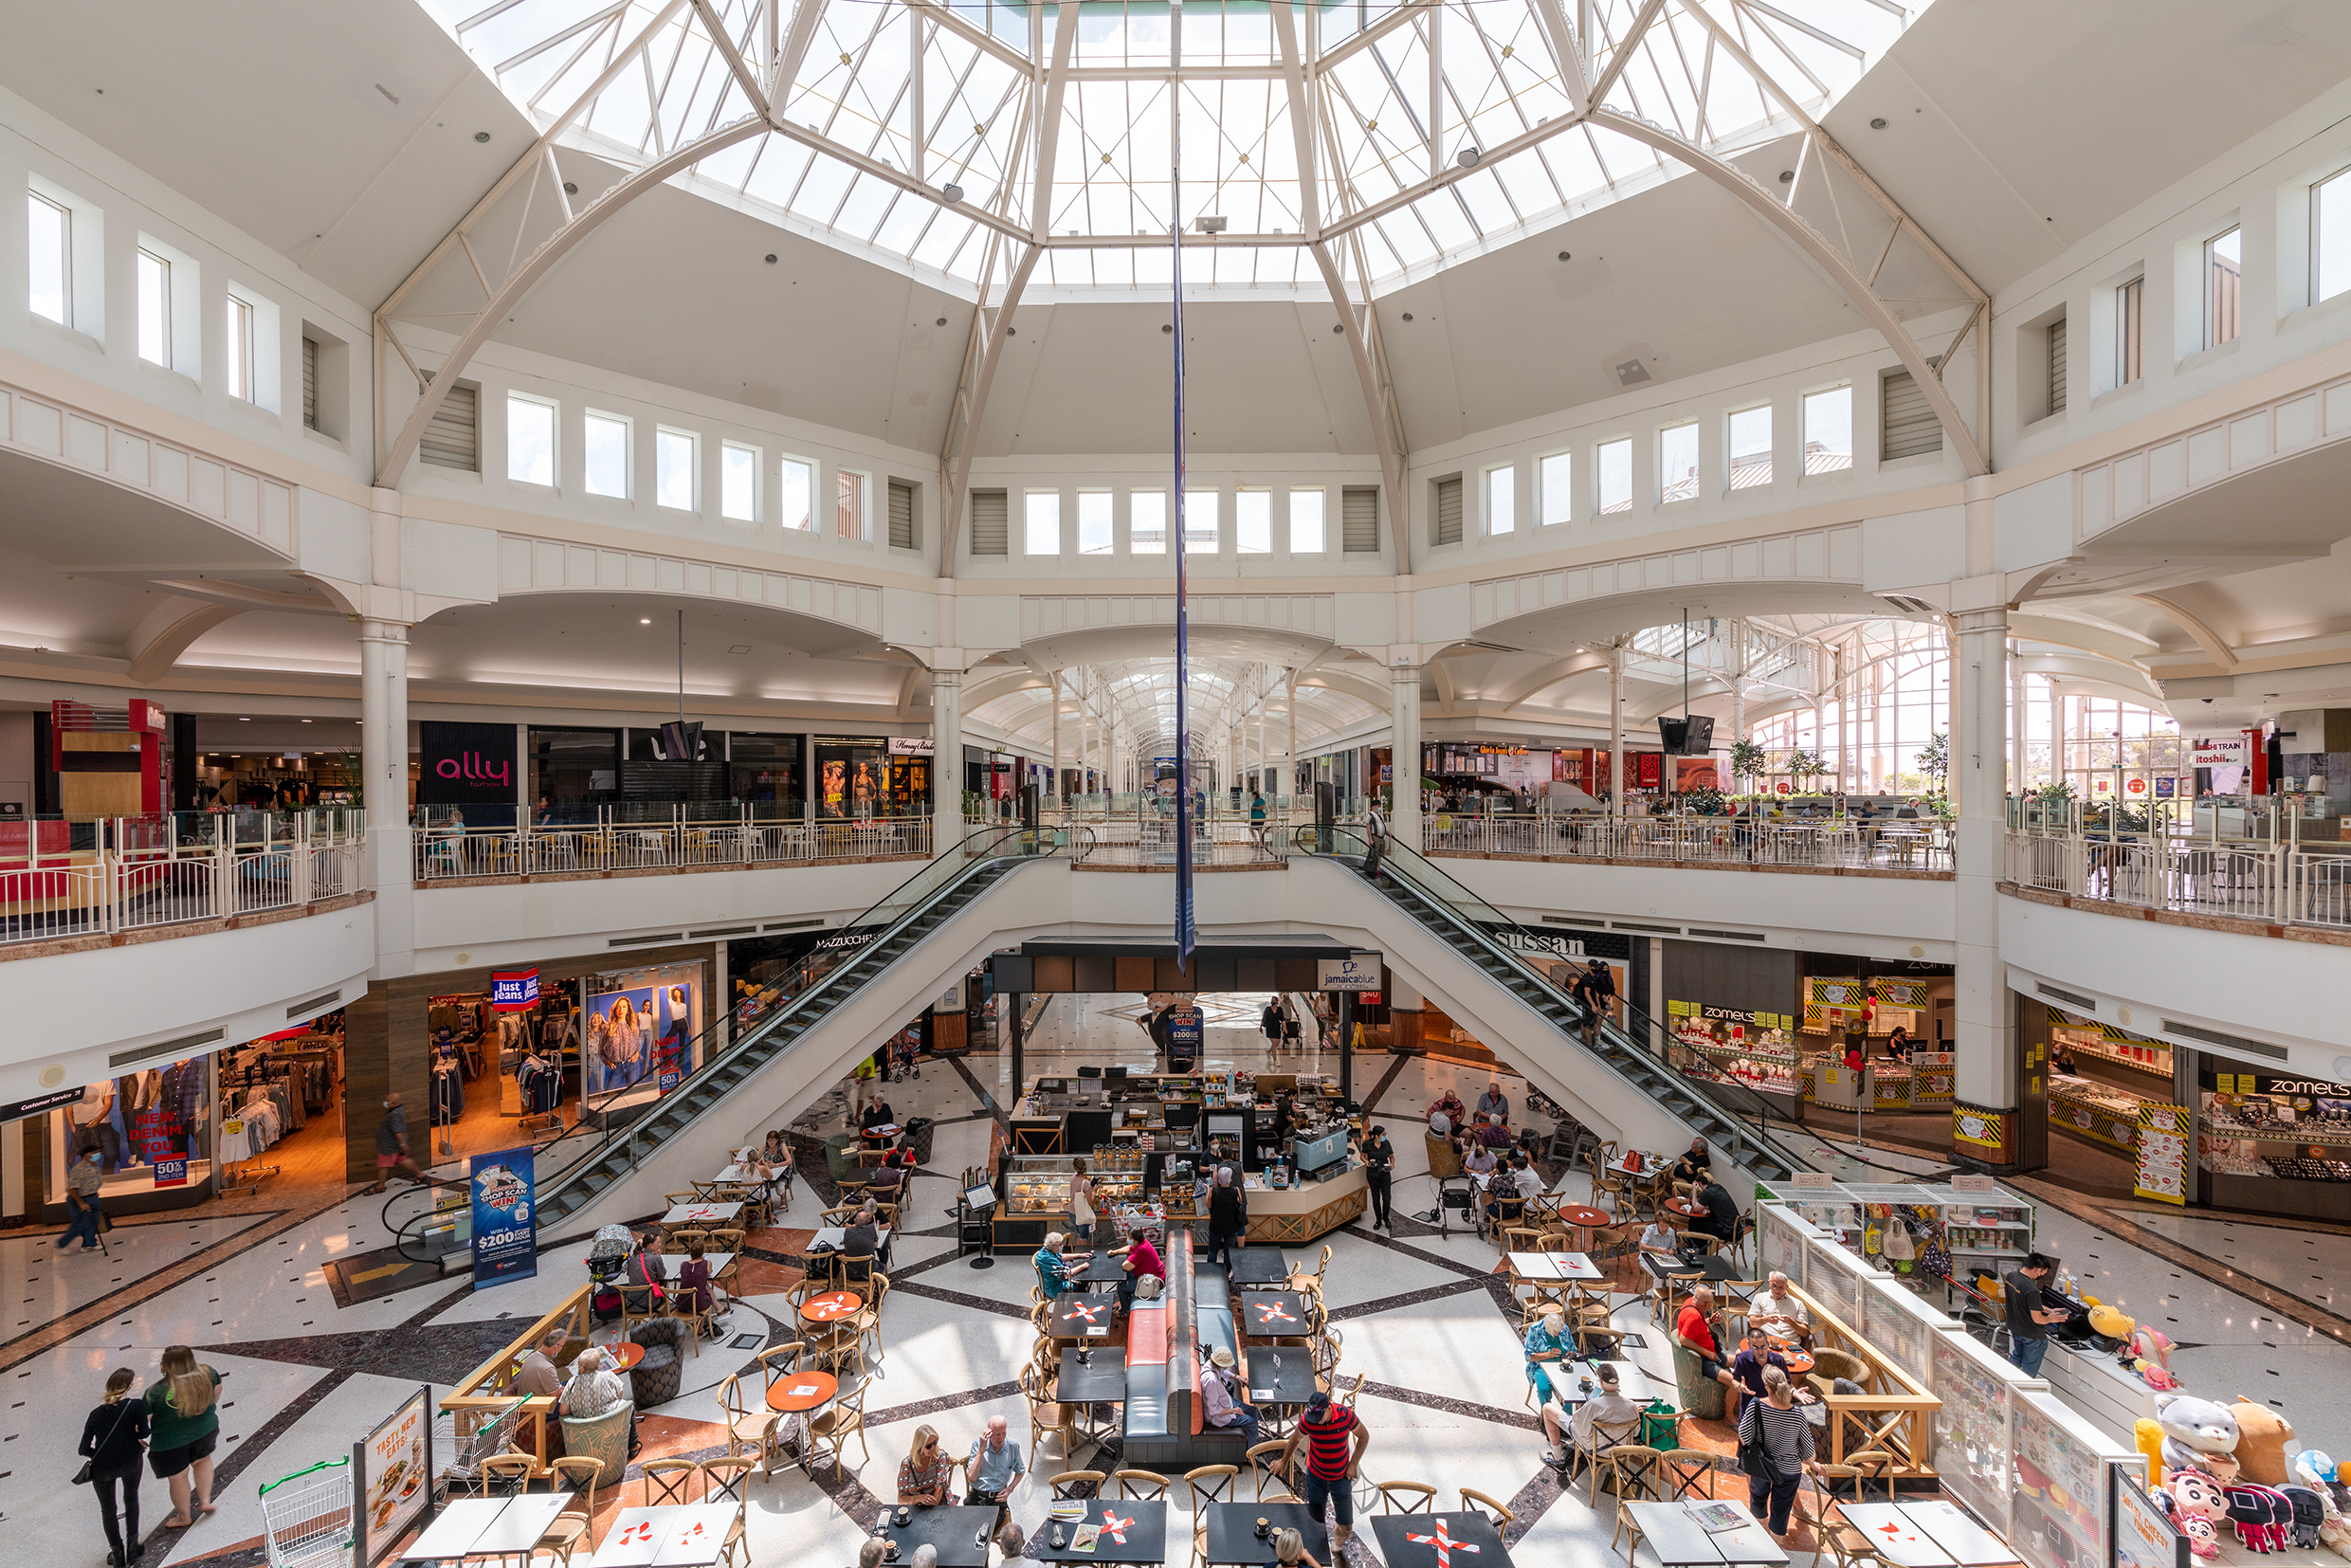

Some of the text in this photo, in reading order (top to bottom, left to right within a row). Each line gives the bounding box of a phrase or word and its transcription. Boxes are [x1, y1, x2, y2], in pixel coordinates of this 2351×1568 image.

[896, 739, 918, 756] Honey
[1480, 746, 1495, 755] Gloria
[1514, 747, 1530, 756] Coffees
[2196, 754, 2226, 763] itoshii
[436, 751, 509, 787] ally
[827, 793, 842, 803] DIXIE
[1495, 932, 1586, 957] sussan
[499, 982, 520, 993] Just
[525, 977, 537, 990] Just
[1324, 975, 1375, 986] jamaicablue
[494, 991, 523, 1001] Jeans
[524, 987, 538, 1000] Jeans
[655, 1035, 680, 1048] NEW.
[21, 1093, 72, 1111] Customer Service
[137, 1111, 180, 1125] NEW.
[2154, 1112, 2174, 1121] DROP
[130, 1124, 186, 1140] DENIM.
[139, 1140, 177, 1154] YOU.
[157, 1161, 182, 1175] 50%
[481, 1188, 527, 1204] SHOP SCAN
[491, 1184, 517, 1194] MONOPOLY
[491, 1195, 518, 1209] WIN!
[478, 1231, 514, 1249] $200
[376, 1413, 417, 1456] TASTY NEW
[386, 1433, 408, 1460] EATS!
